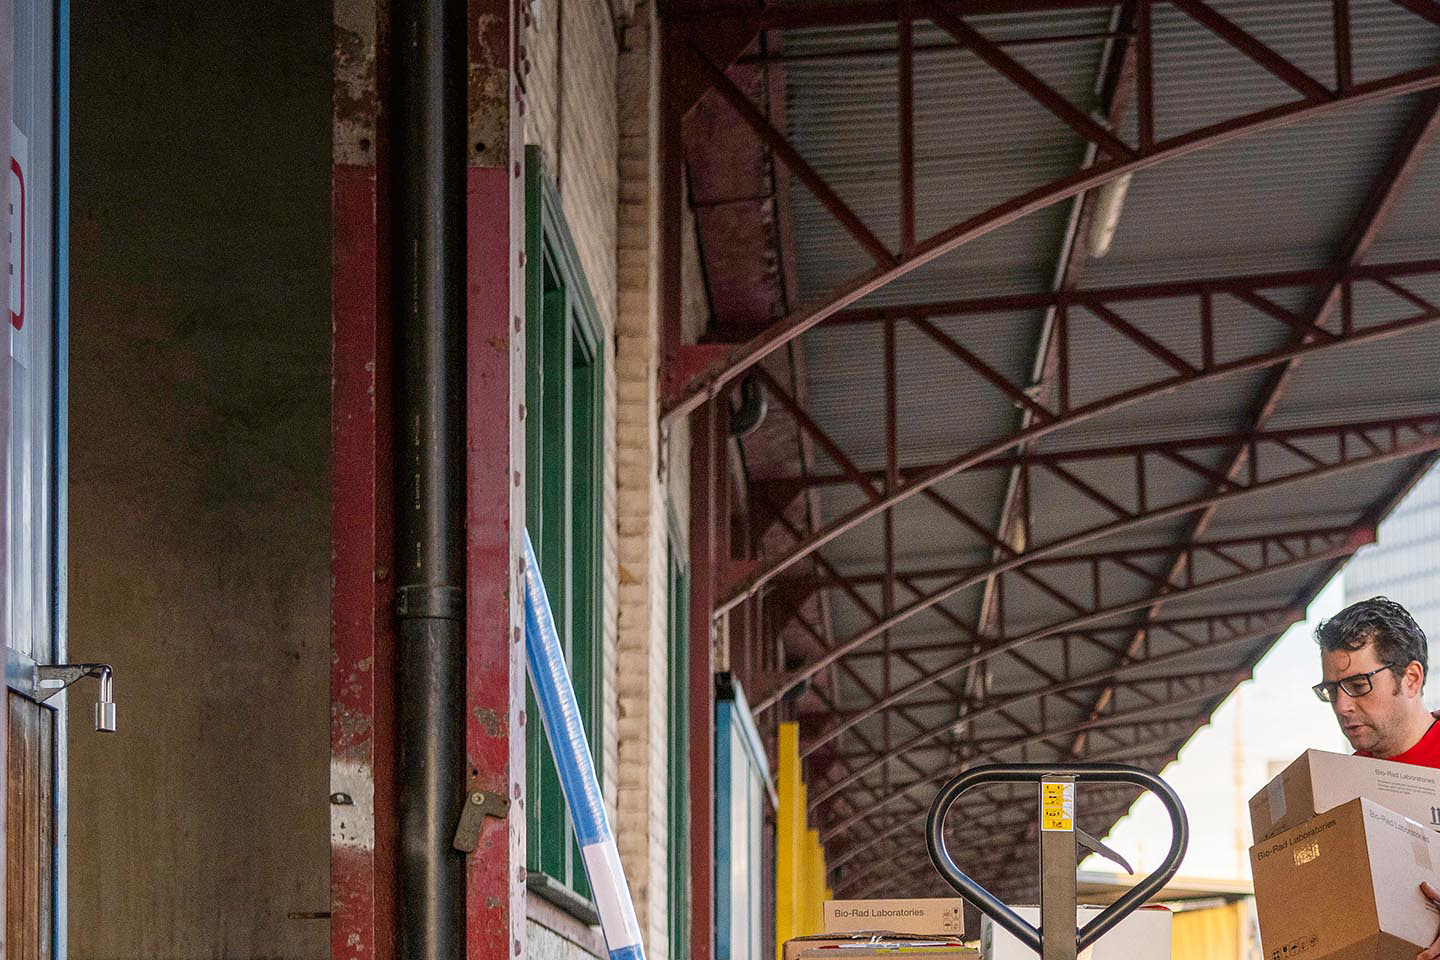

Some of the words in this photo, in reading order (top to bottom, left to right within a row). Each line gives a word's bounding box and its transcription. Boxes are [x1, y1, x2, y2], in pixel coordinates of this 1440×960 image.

[1257, 841, 1288, 861] Bio-Rad
[1289, 819, 1337, 846] Laboratories
[834, 909, 869, 918] Bio-Rad
[872, 908, 925, 917] Laboratories
